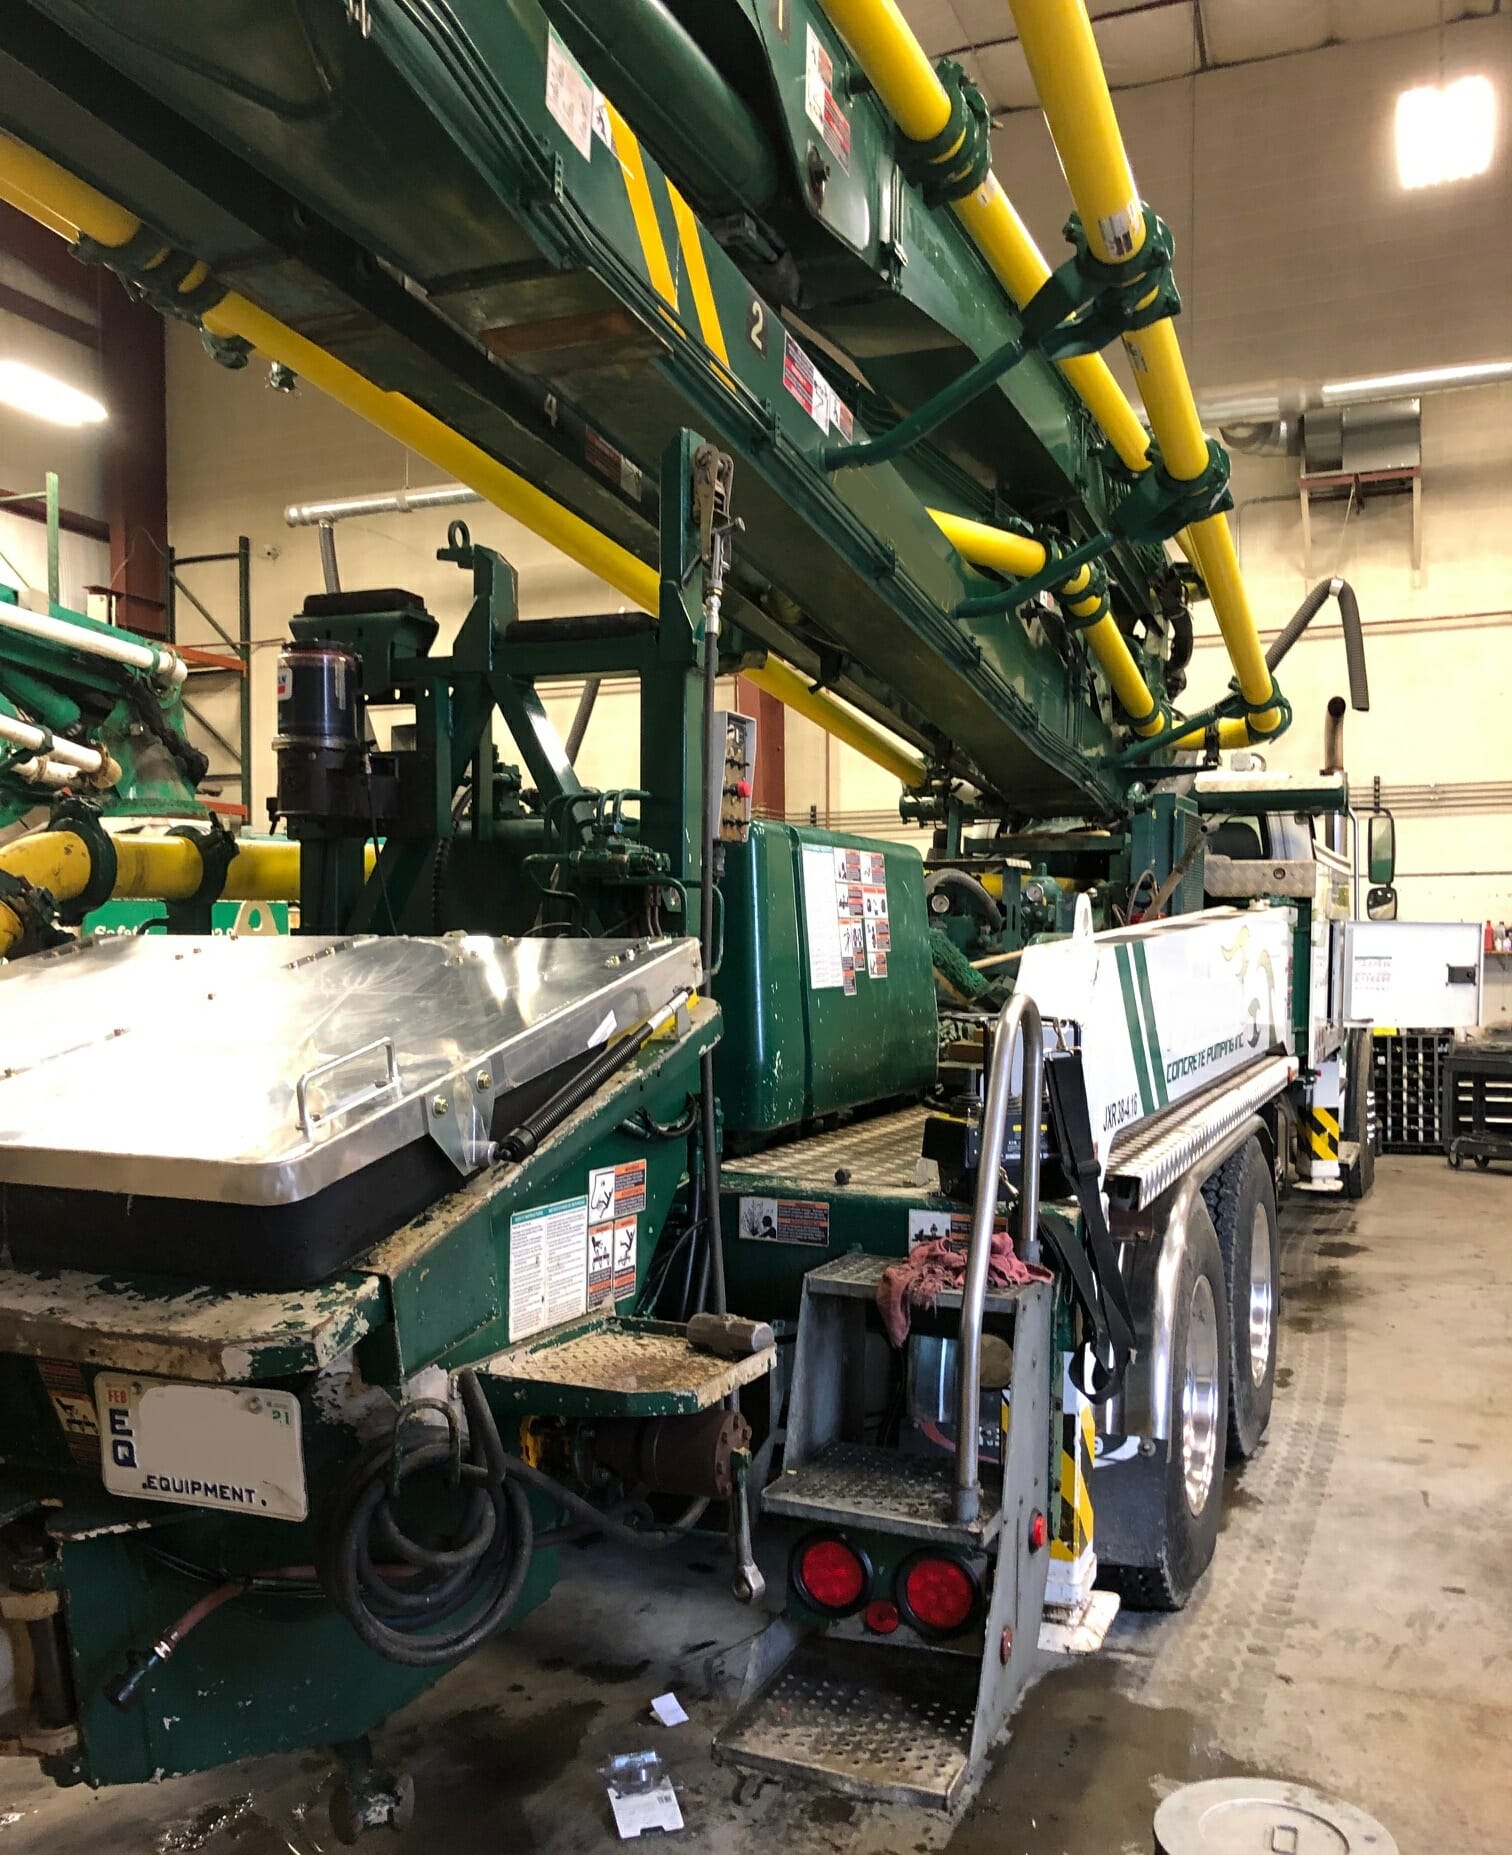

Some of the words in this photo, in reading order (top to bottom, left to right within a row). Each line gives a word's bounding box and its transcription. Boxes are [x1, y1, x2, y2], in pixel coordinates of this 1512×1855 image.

[750, 300, 764, 351] 2
[544, 392, 558, 428] 4
[1166, 1050, 1206, 1084] CONCRETE
[1206, 1037, 1234, 1065] PUMPING
[1103, 1102, 1117, 1132] JXR
[108, 1390, 128, 1404] FEB
[146, 1475, 256, 1504] EQUIPMENT
